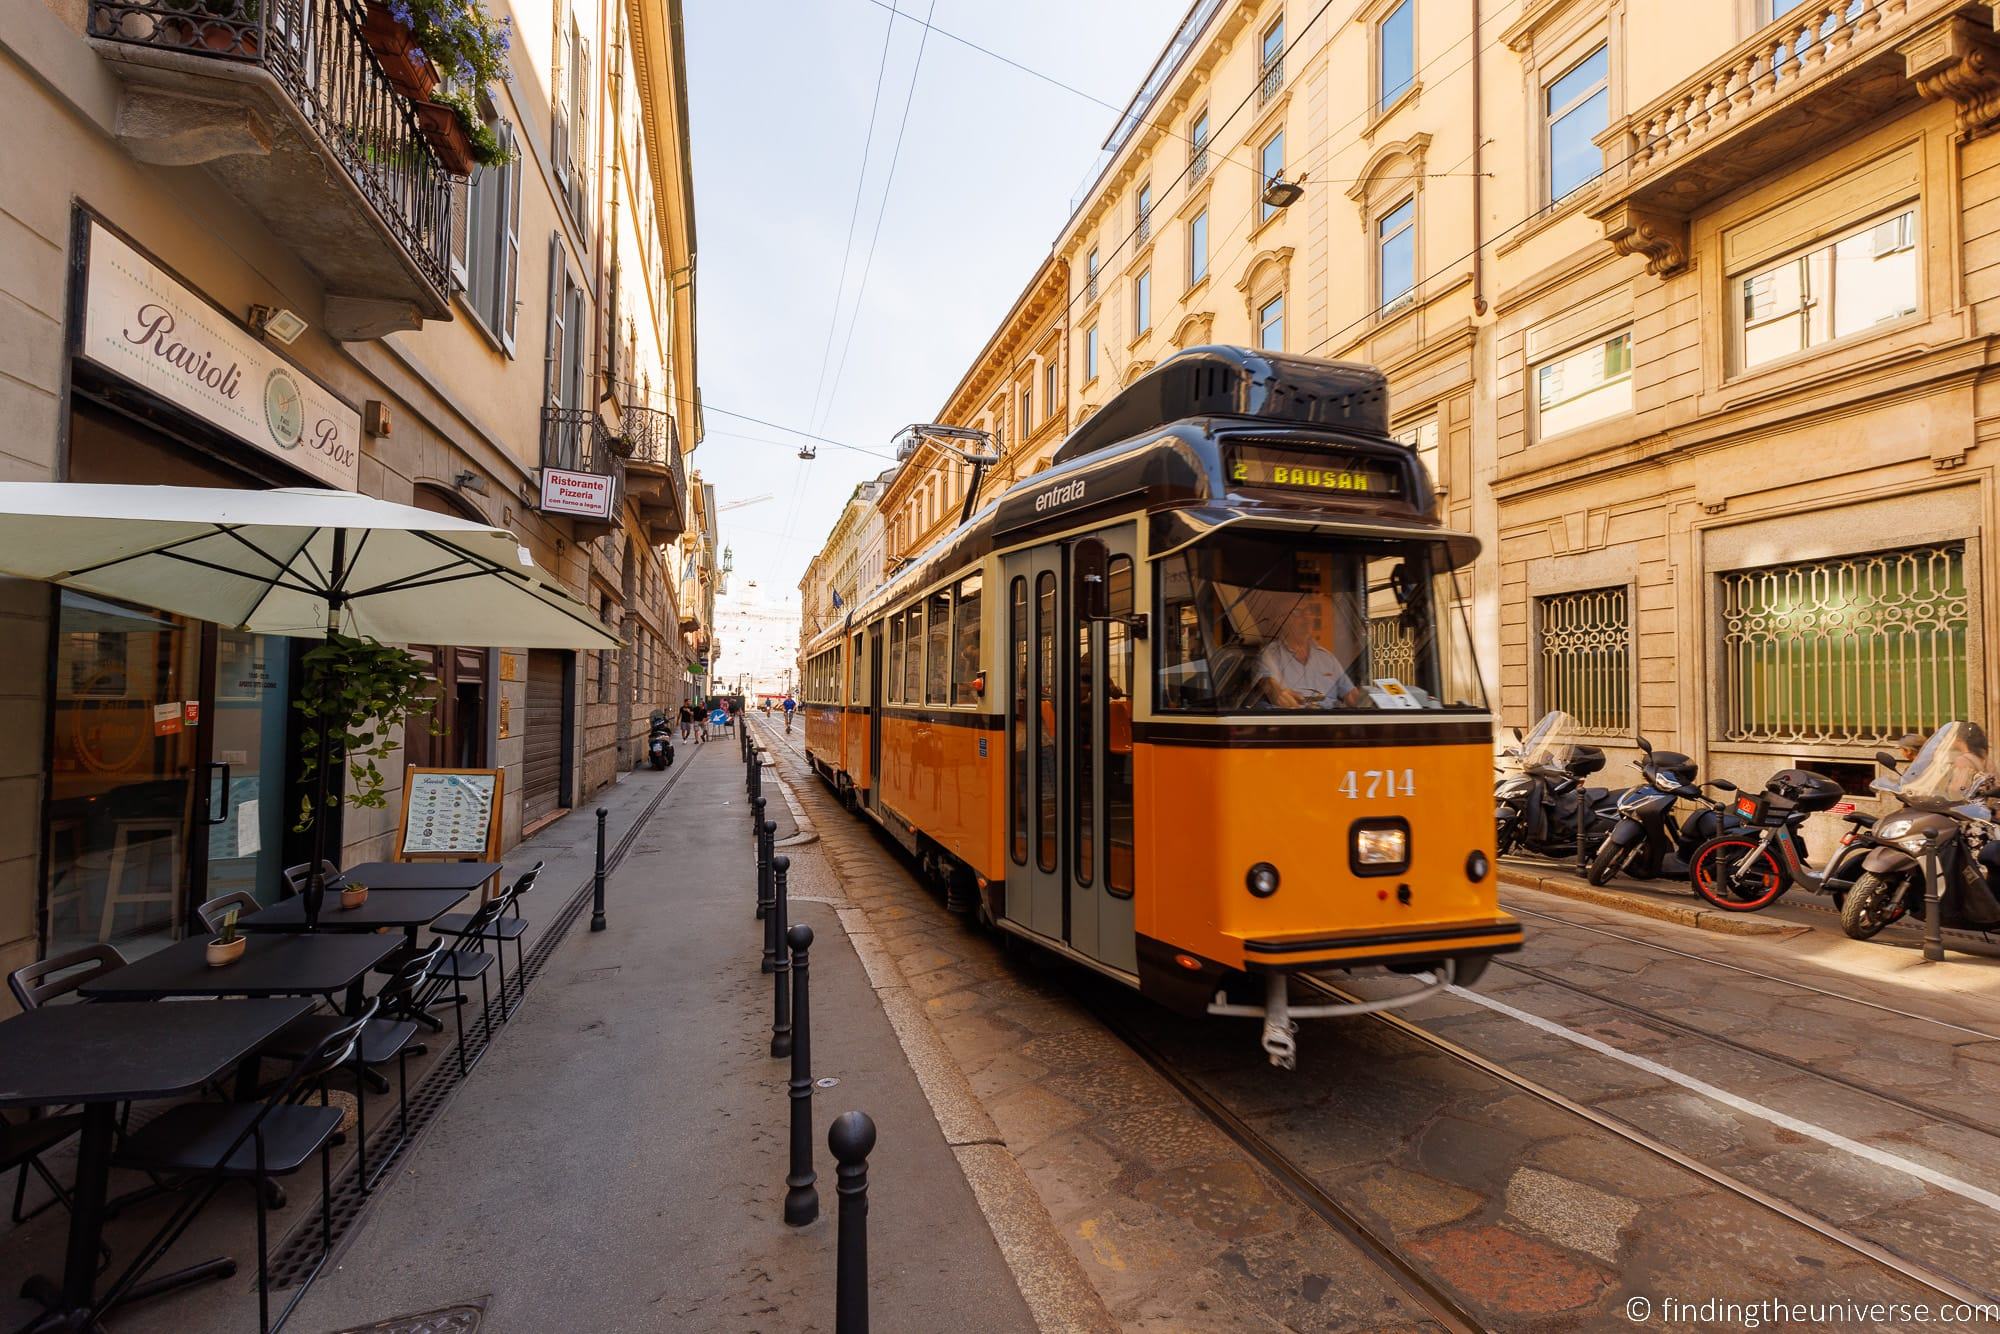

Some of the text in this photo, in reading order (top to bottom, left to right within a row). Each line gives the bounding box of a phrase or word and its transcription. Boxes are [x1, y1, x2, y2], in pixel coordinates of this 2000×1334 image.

[123, 304, 354, 467] Ravioli Box
[551, 475, 604, 490] Ristorante
[1233, 463, 1368, 490] 2 BAUSAN
[559, 488, 593, 499] Pizzeria
[1035, 480, 1085, 512] entrata
[1338, 768, 1417, 799] 4714
